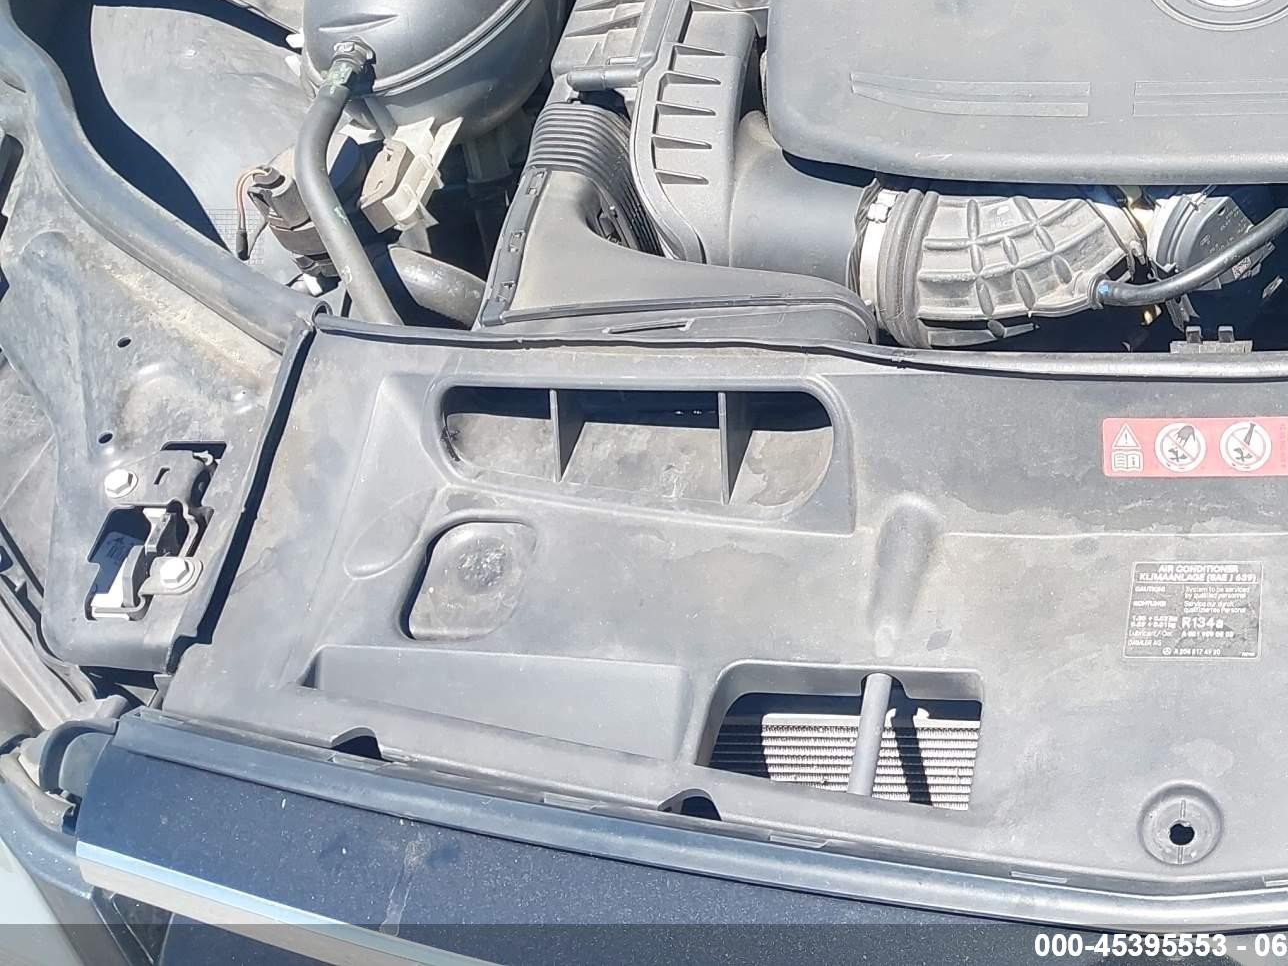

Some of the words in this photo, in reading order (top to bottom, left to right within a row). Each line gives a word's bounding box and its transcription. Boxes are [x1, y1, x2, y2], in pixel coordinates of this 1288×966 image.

[1159, 564, 1174, 573] AIR
[1175, 564, 1239, 573] CONDITIONER
[1139, 573, 1205, 582] KLIMAANLAGE
[1181, 616, 1224, 629] R134a
